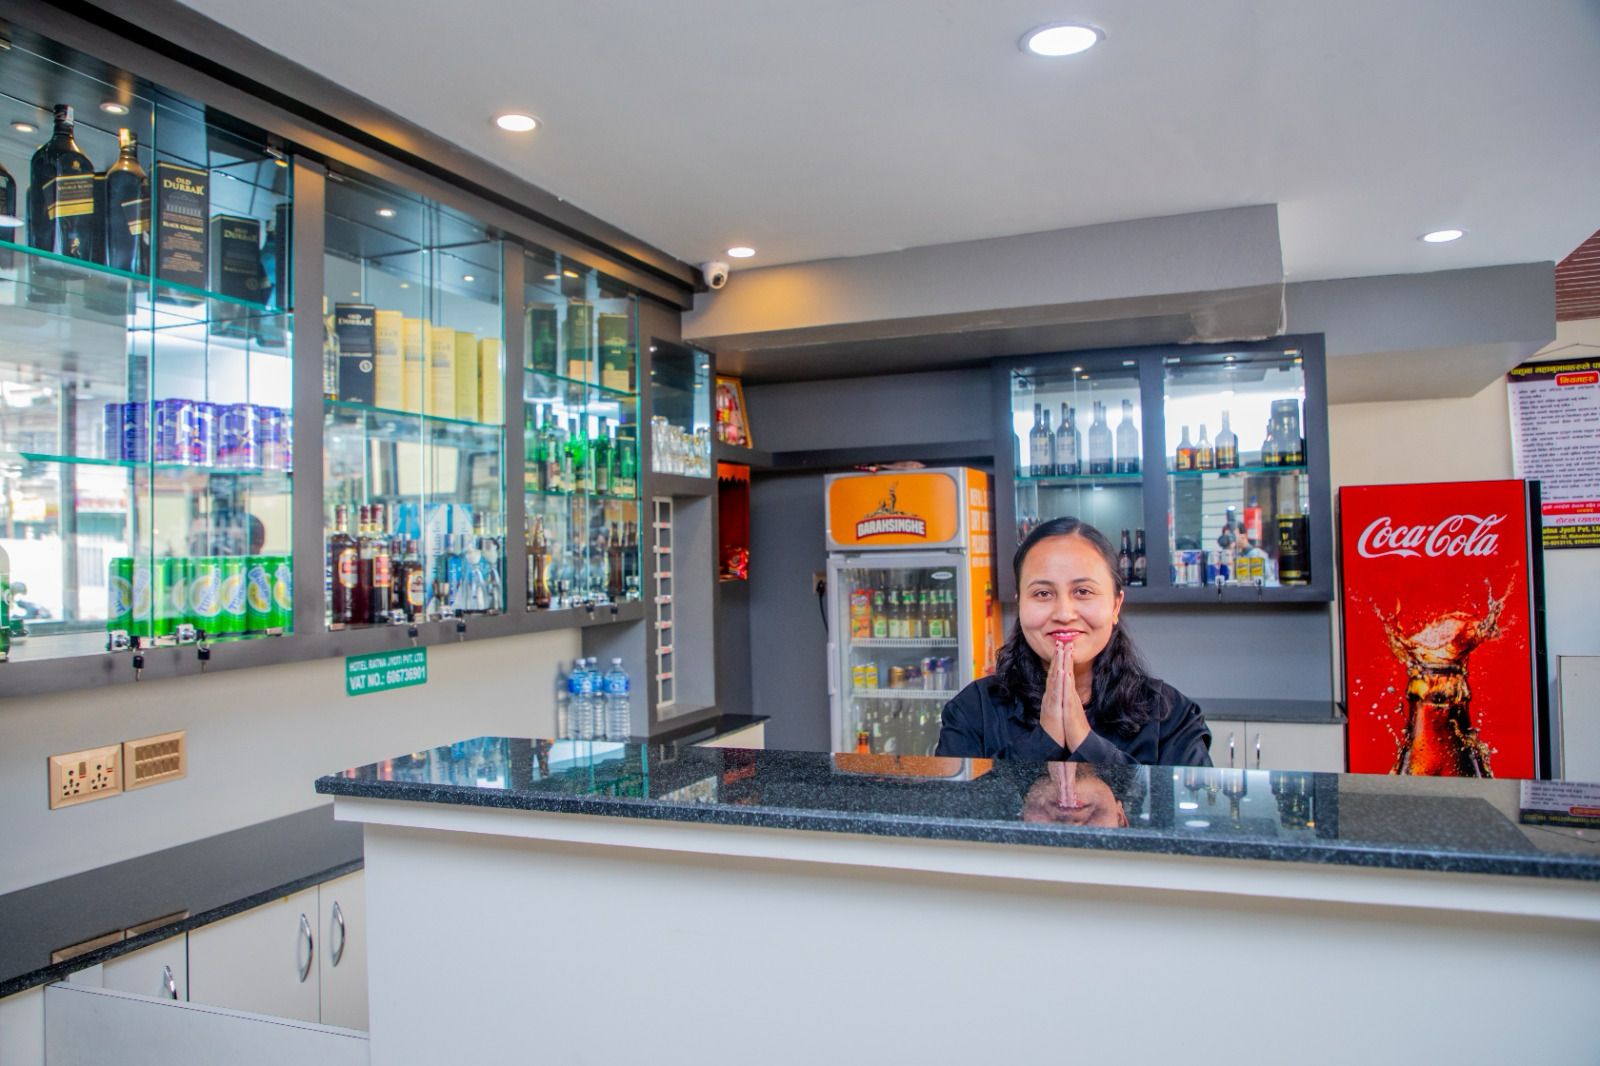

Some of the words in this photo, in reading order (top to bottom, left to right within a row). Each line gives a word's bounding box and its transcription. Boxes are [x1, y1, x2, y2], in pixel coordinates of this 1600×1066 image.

[175, 177, 191, 185] OLD
[1357, 513, 1508, 559] Coca-Cola
[349, 674, 366, 690] VAT
